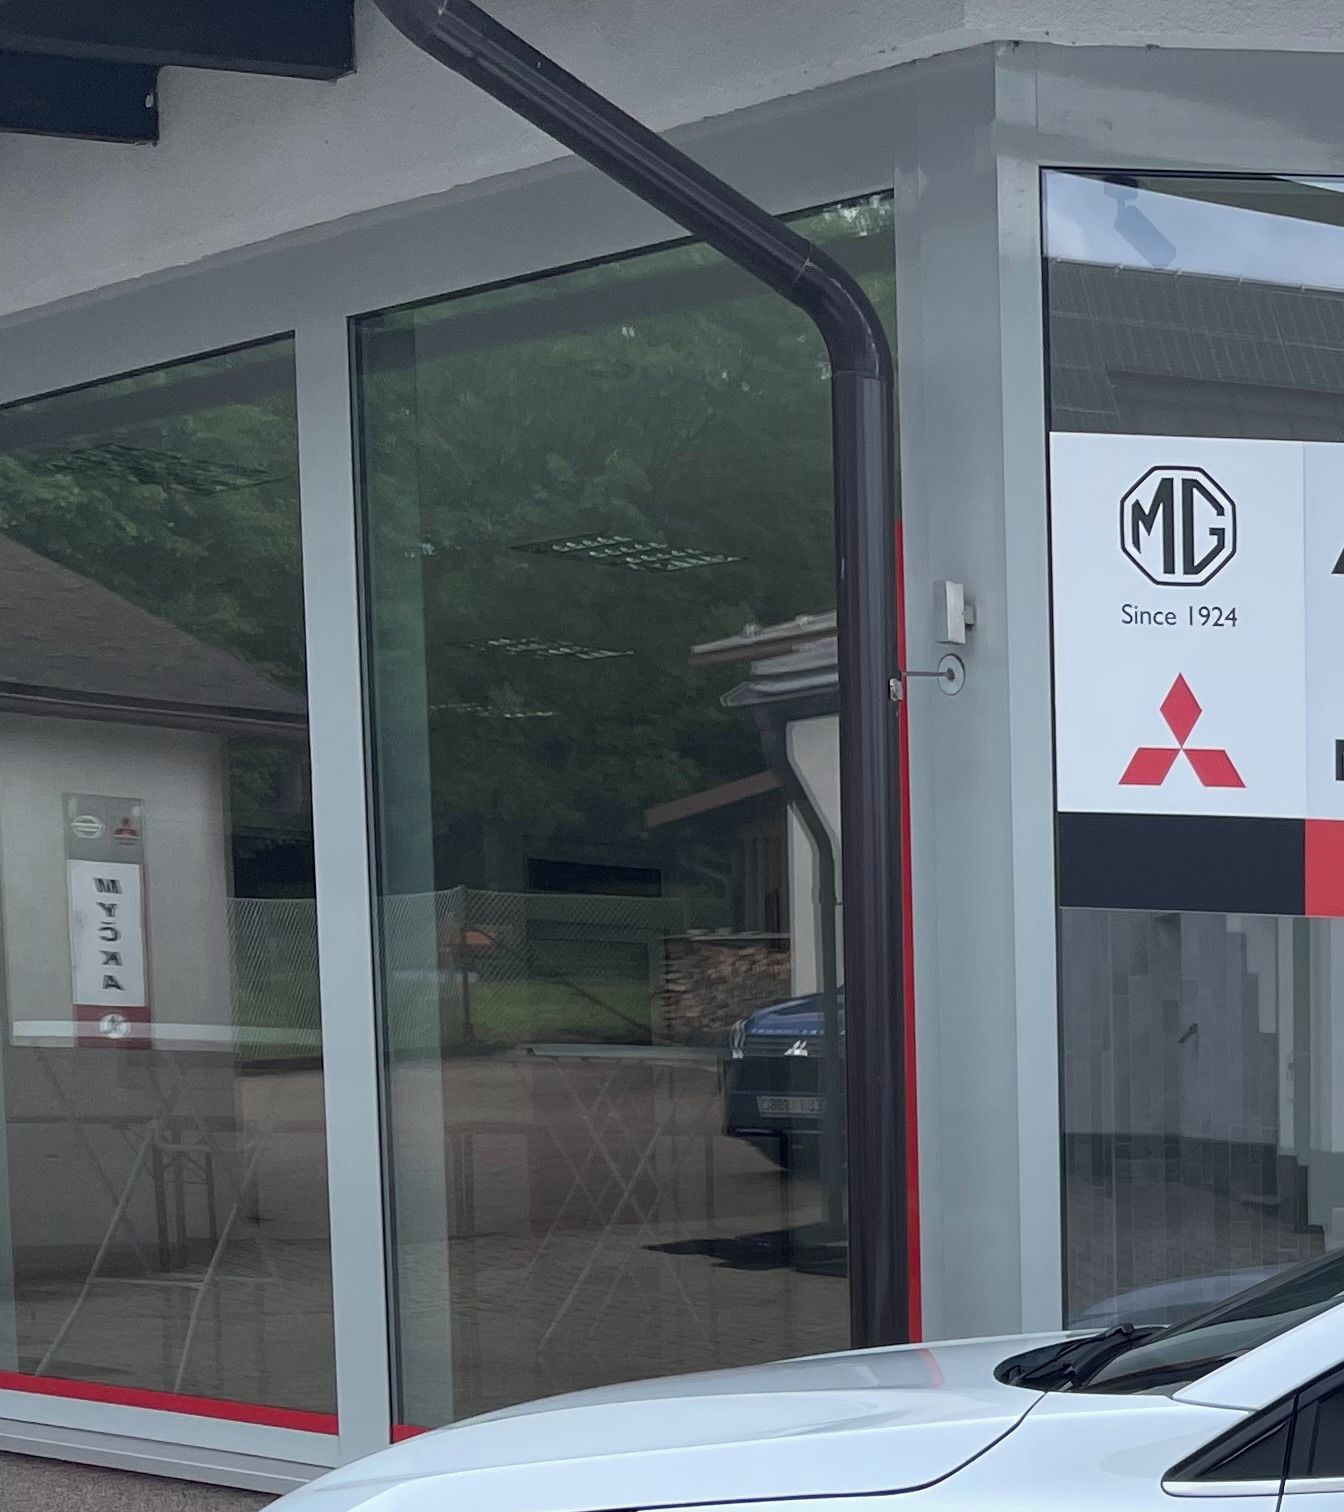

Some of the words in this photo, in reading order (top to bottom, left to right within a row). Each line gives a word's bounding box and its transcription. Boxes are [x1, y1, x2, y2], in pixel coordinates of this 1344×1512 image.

[1126, 472, 1231, 580] MG
[1121, 603, 1177, 626] Since
[1189, 605, 1238, 628] 1924
